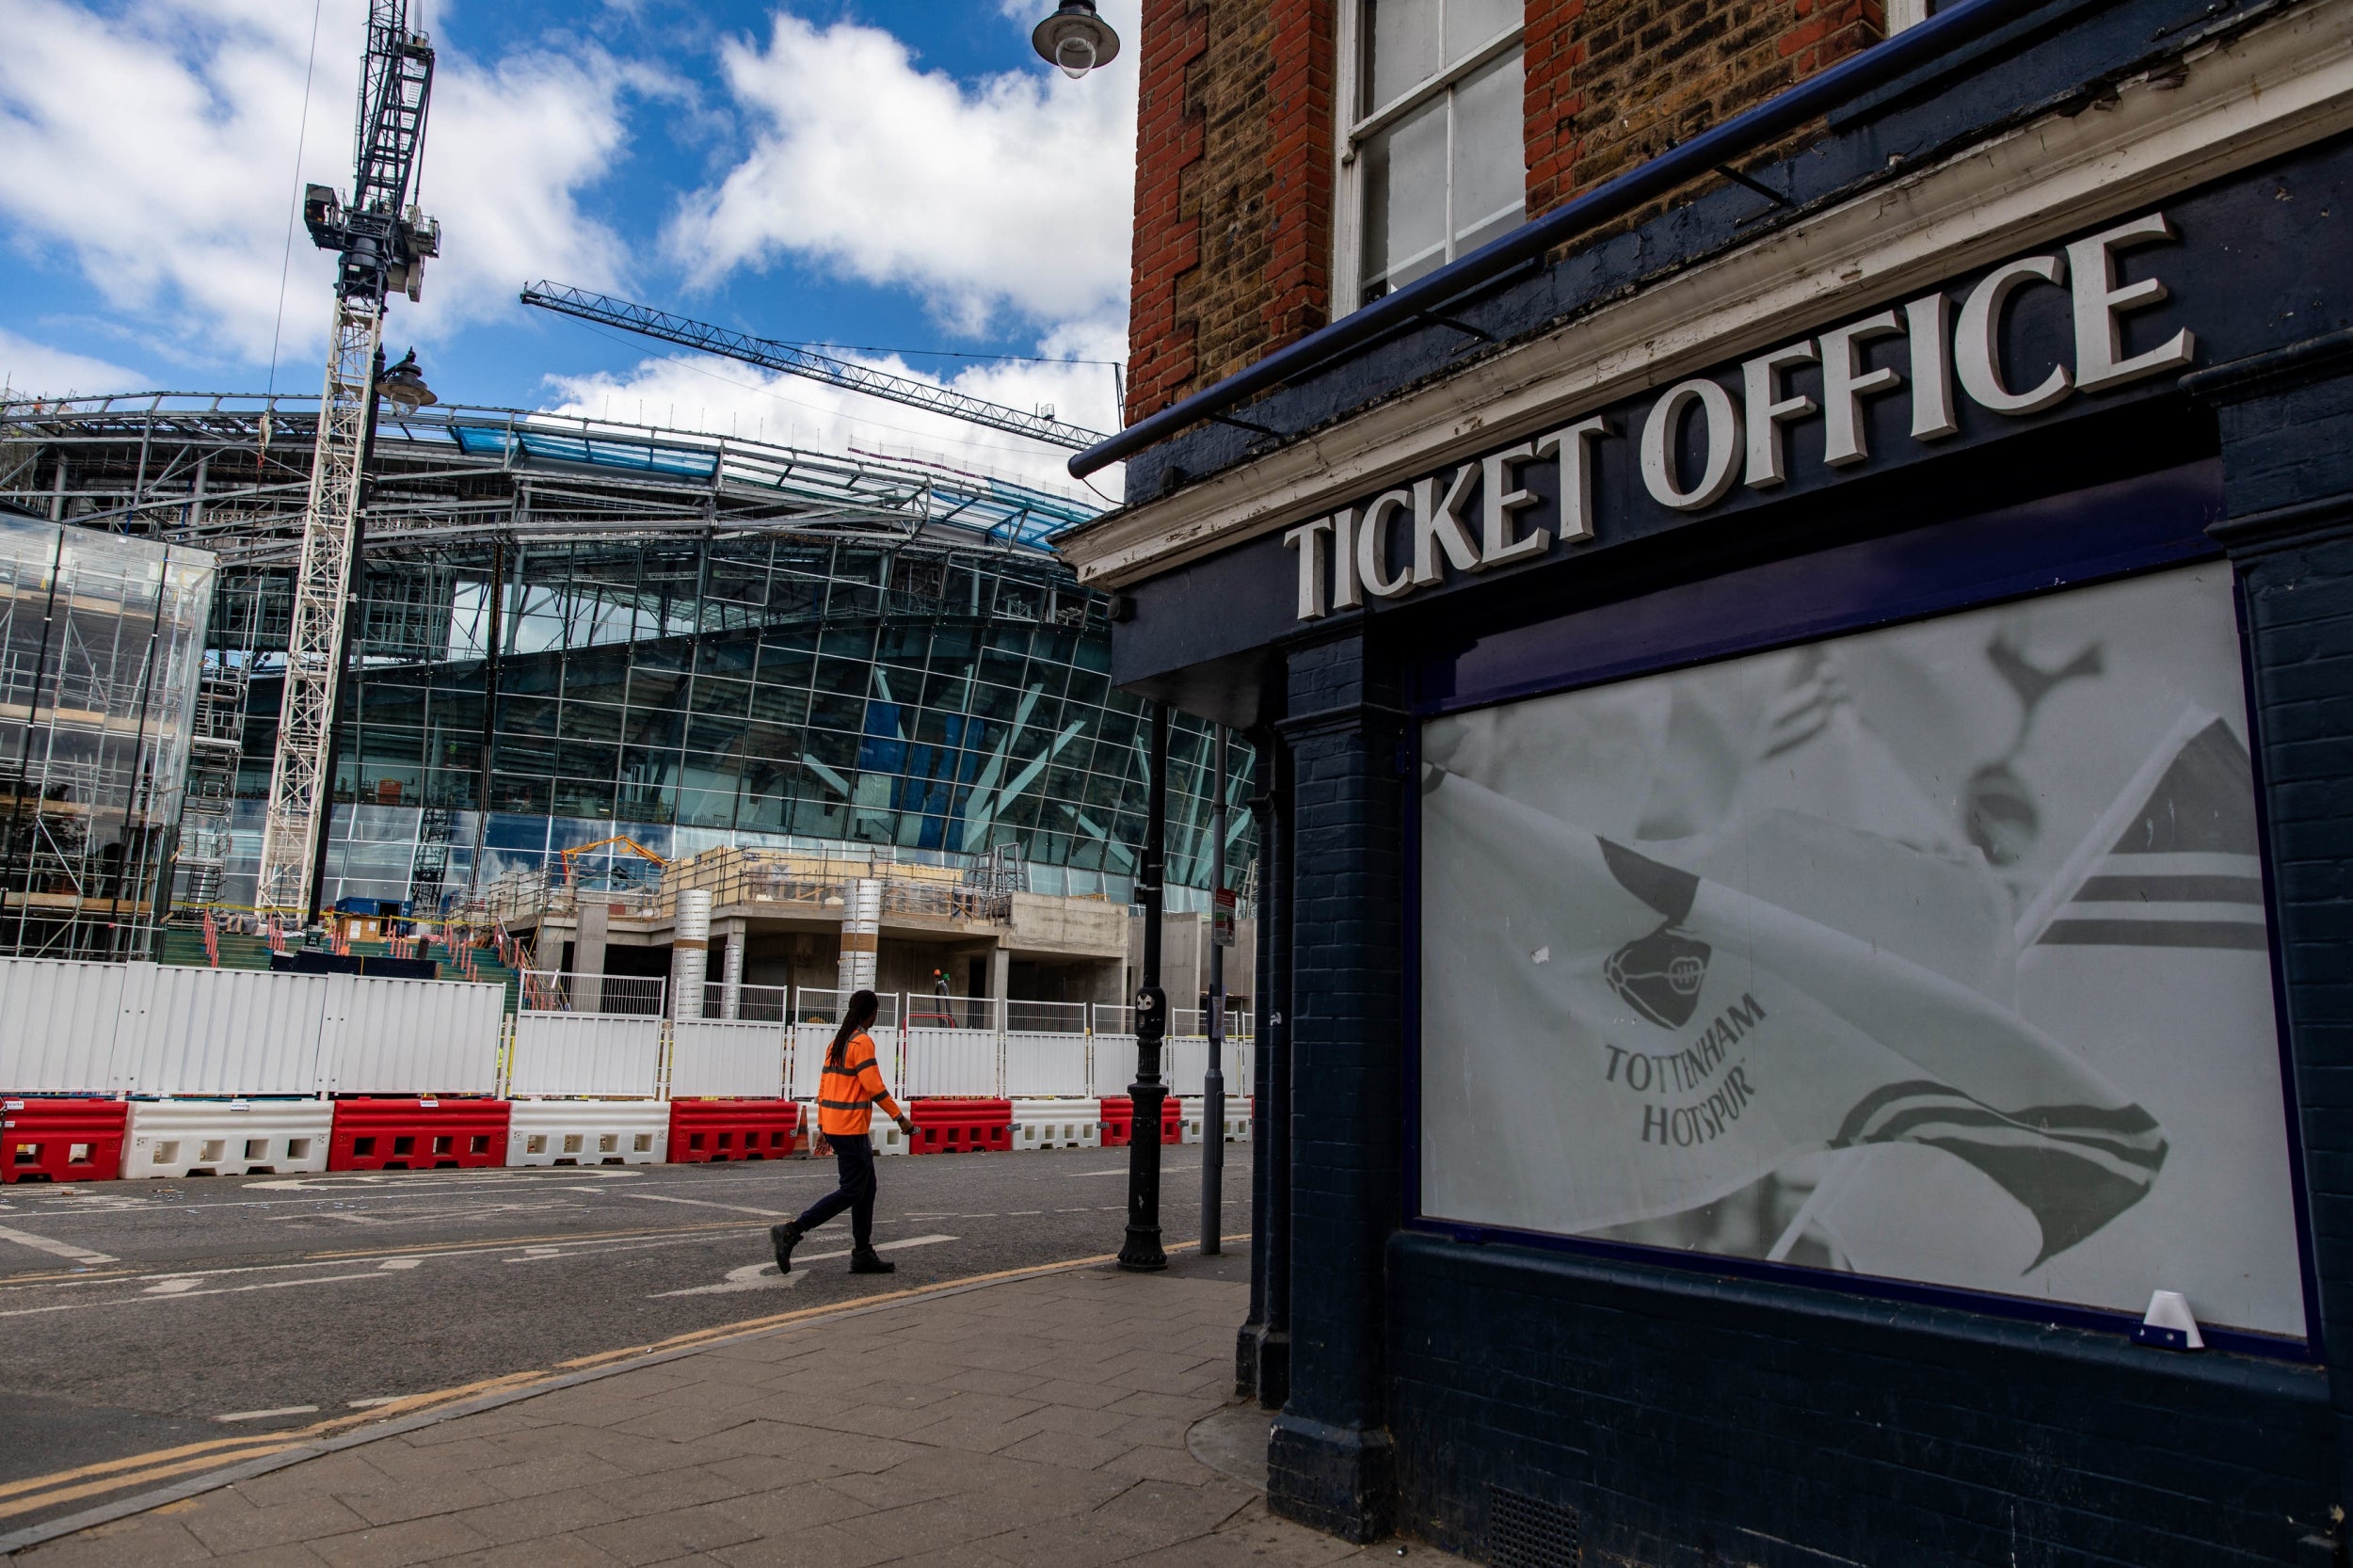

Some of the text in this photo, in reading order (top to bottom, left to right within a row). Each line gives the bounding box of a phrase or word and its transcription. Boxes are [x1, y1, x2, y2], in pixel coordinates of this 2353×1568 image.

[1284, 212, 2195, 622] TICKET OFFICE
[1606, 993, 1767, 1093] TOTTENHAM
[1641, 1064, 1754, 1146] HOTSPUR
